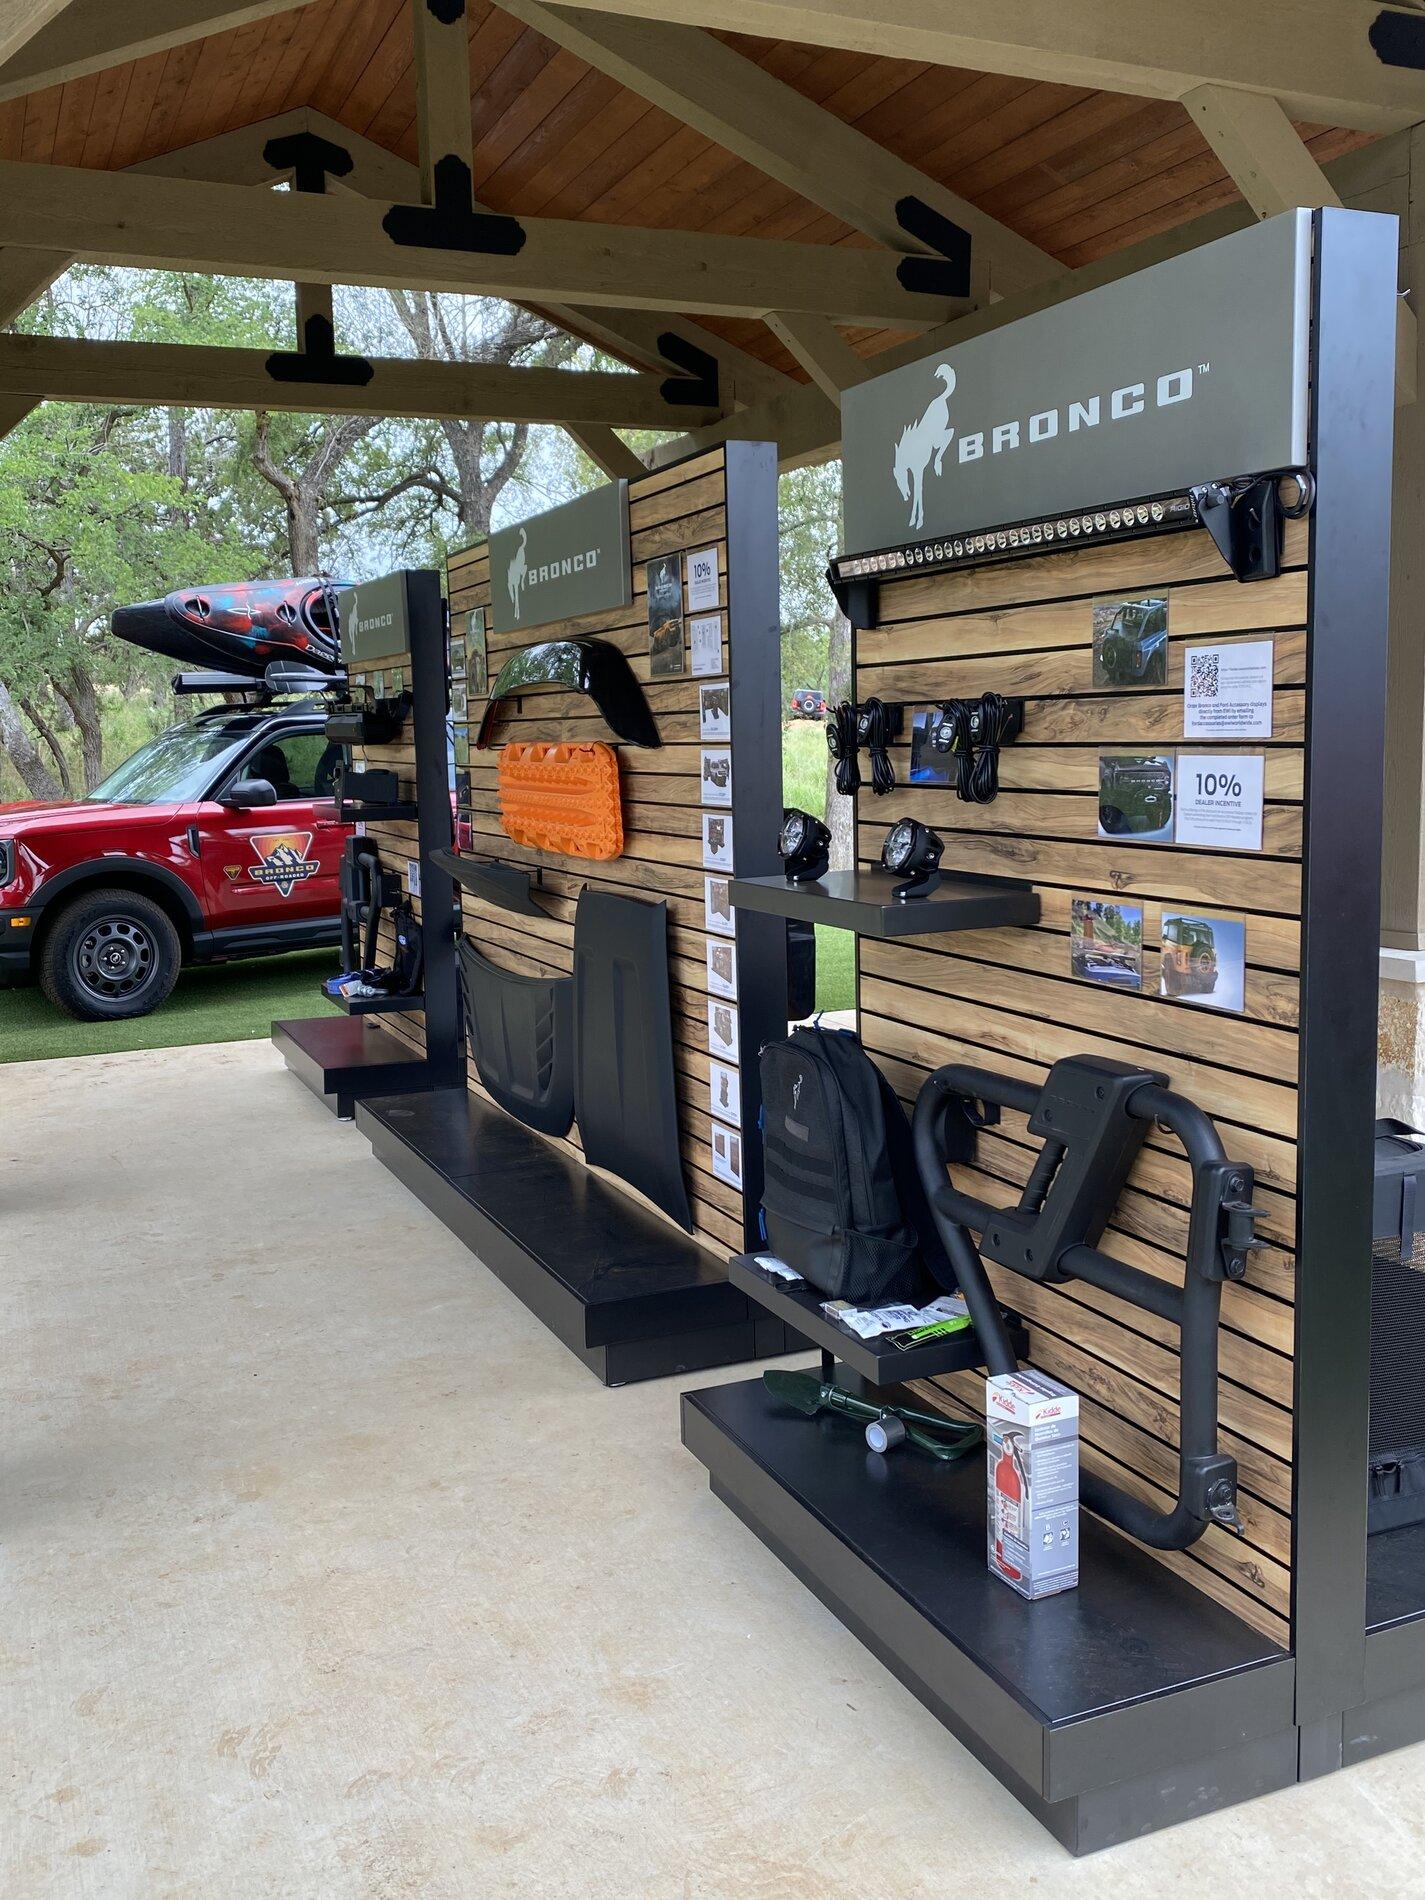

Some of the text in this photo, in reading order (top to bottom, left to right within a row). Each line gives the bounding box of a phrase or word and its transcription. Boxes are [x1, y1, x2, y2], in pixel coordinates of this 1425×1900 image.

[958, 368, 1193, 464] BRONCO
[528, 550, 597, 585] BRONCO
[693, 562, 711, 579] 10%
[358, 613, 393, 633] BRONCO
[1196, 772, 1242, 797] 10%
[254, 864, 315, 876] BRONCO
[1042, 1405, 1062, 1416] Kidde
